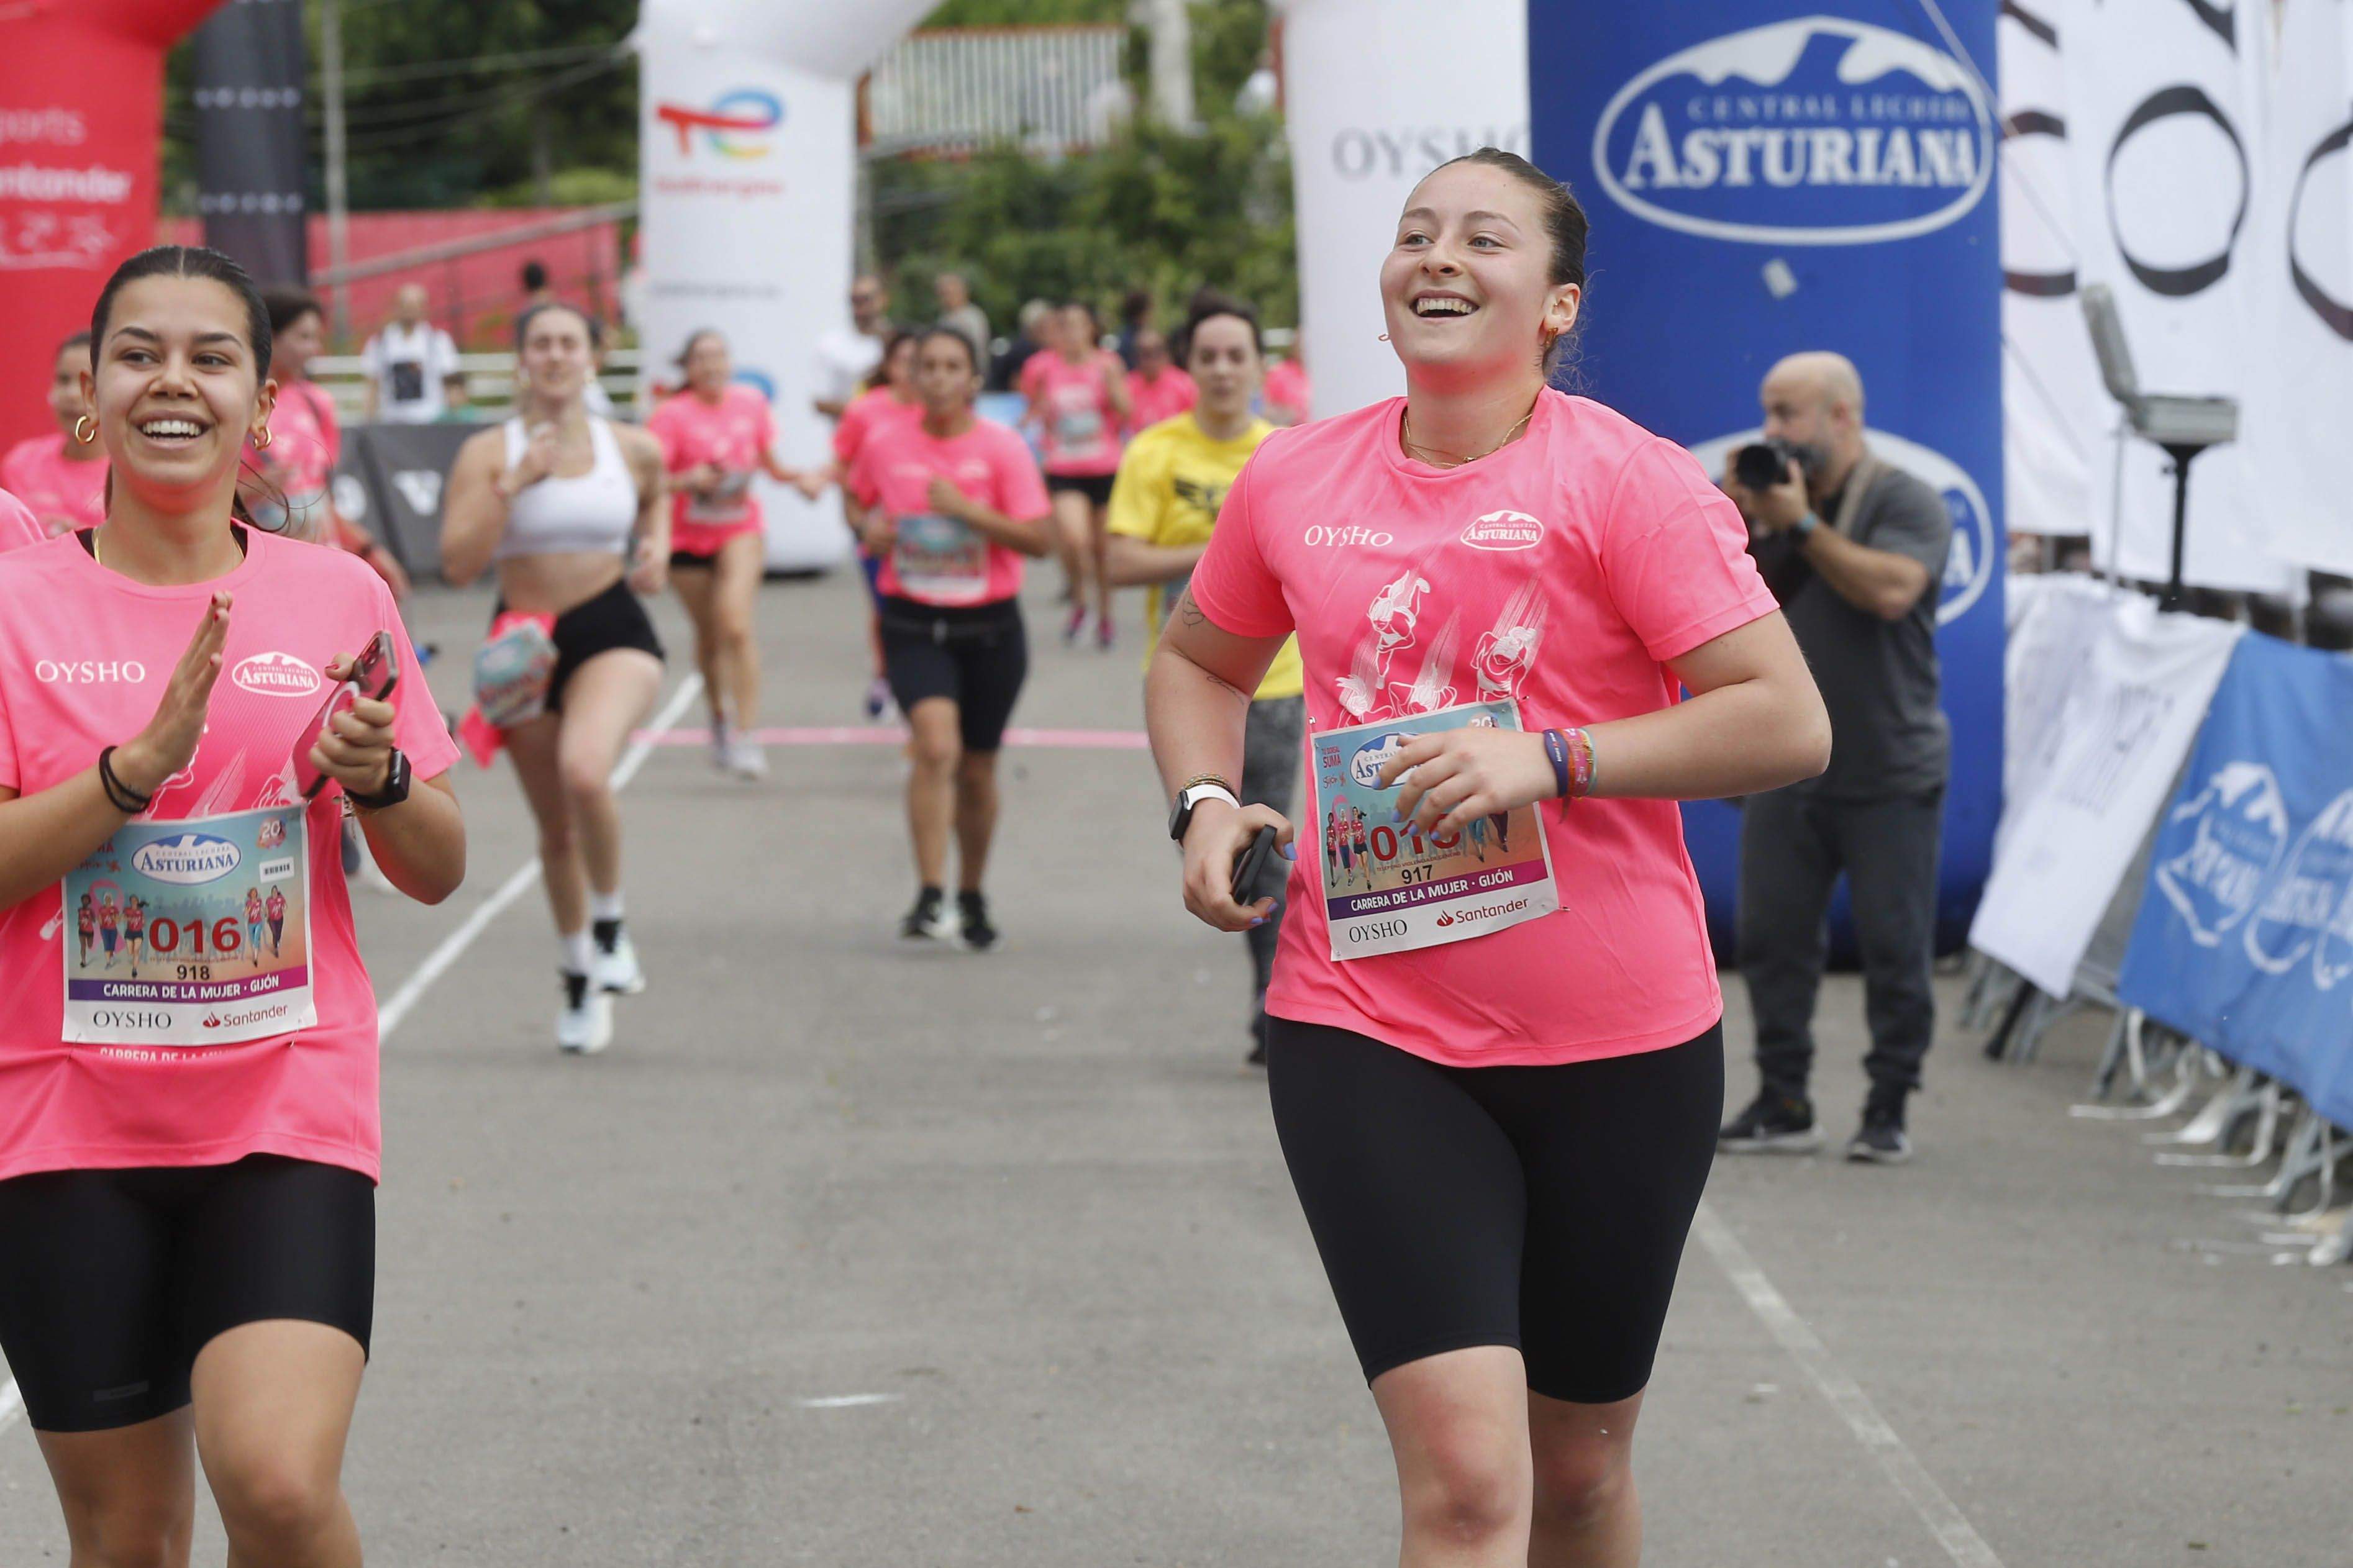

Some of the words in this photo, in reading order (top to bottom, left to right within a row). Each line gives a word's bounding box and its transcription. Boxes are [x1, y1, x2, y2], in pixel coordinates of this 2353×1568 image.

[1687, 95, 1839, 120] CENTRAL
[1332, 126, 1529, 180] OYS
[1304, 525, 1393, 547] OYSHO
[1467, 526, 1537, 542] ASTURIANA
[35, 659, 145, 684] OYSHO
[240, 666, 315, 688] ASTURIANA
[1323, 754, 1342, 768] SUMA
[262, 820, 281, 838] 20
[141, 851, 235, 872] ASTURIANA
[1401, 864, 1432, 884] 917
[1350, 897, 1391, 911] CARRERA
[1393, 893, 1408, 905] DE
[1410, 888, 1425, 901] LA
[1428, 882, 1469, 898] MUJER
[1478, 869, 1514, 887] GIJÓN
[1455, 898, 1529, 923] Santander
[148, 917, 242, 953] 016
[1349, 918, 1408, 943] OYSHO
[176, 964, 210, 980] 918
[103, 983, 158, 998] CARRERA
[161, 983, 177, 999] DE
[180, 986, 196, 999] LA
[200, 981, 241, 999] MUJER
[250, 972, 280, 994] GIJÓN
[93, 1010, 172, 1028] OYSHO
[224, 1004, 288, 1027] Santander
